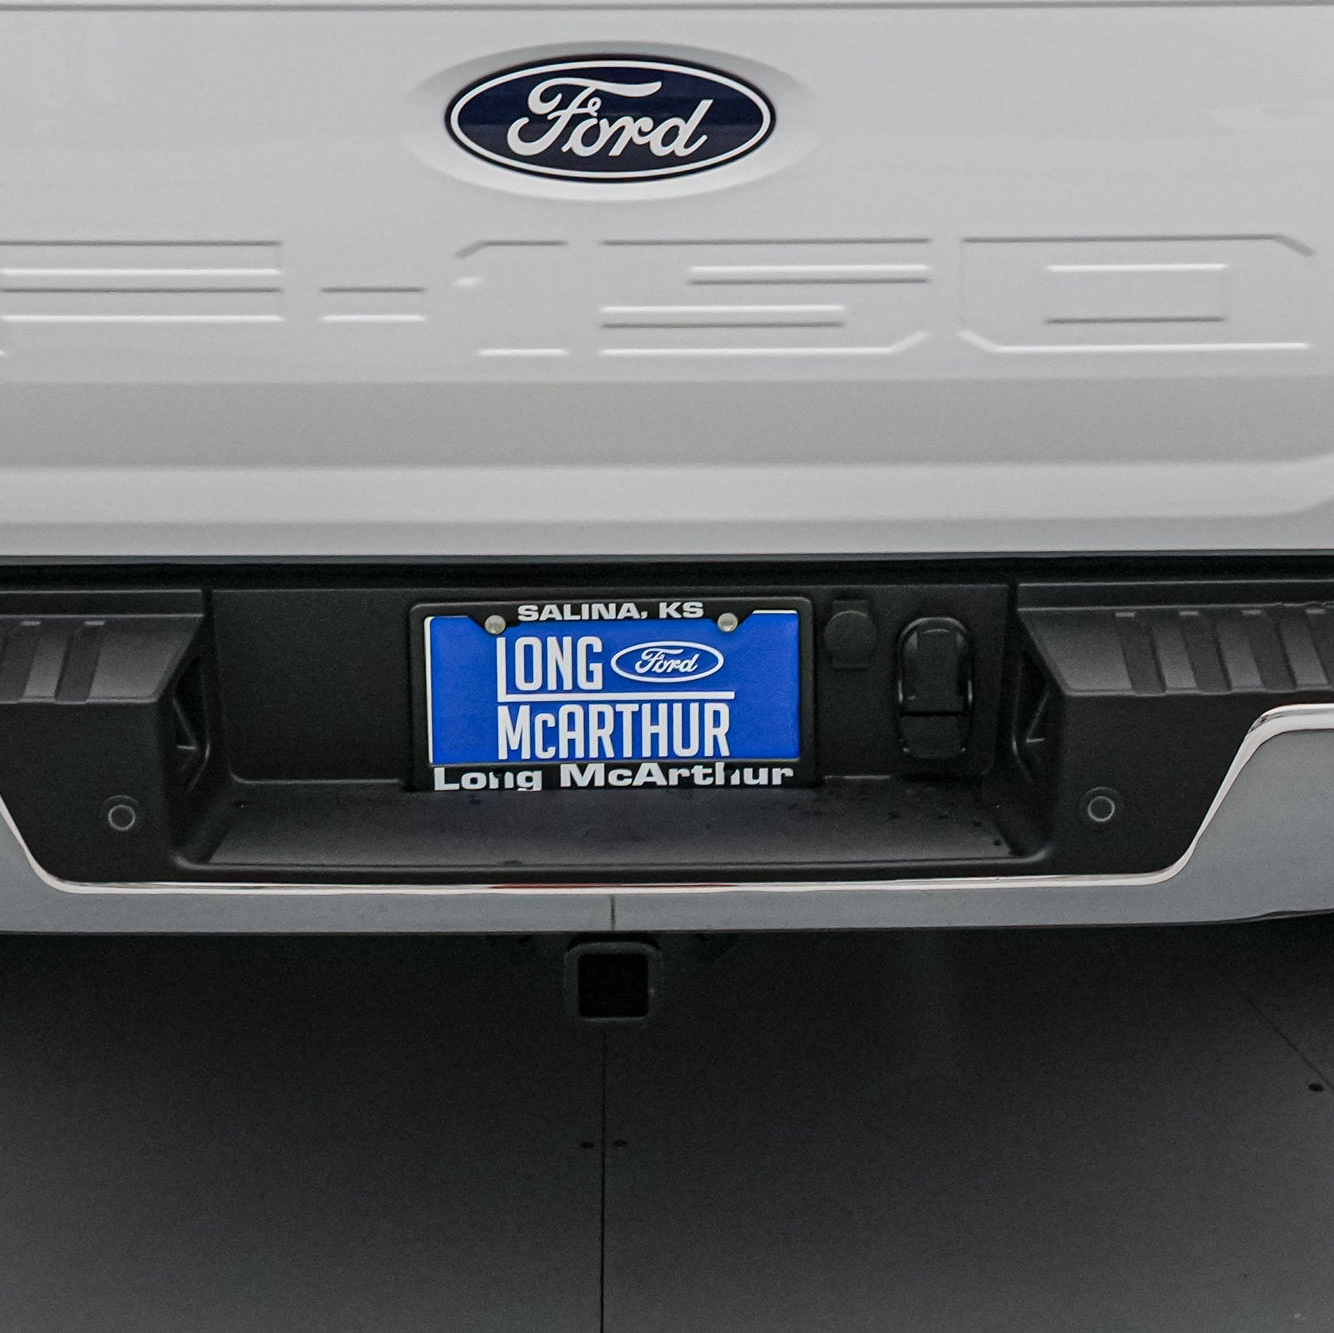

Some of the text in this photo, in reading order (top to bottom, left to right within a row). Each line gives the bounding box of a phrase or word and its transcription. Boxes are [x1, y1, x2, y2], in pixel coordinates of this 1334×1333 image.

[506, 77, 714, 157] Ford
[517, 601, 705, 622] SALINA, KS
[496, 636, 604, 702] LONG
[634, 648, 700, 675] Ford
[497, 702, 731, 760] McARTHUR
[433, 762, 794, 792] Long McArthur
